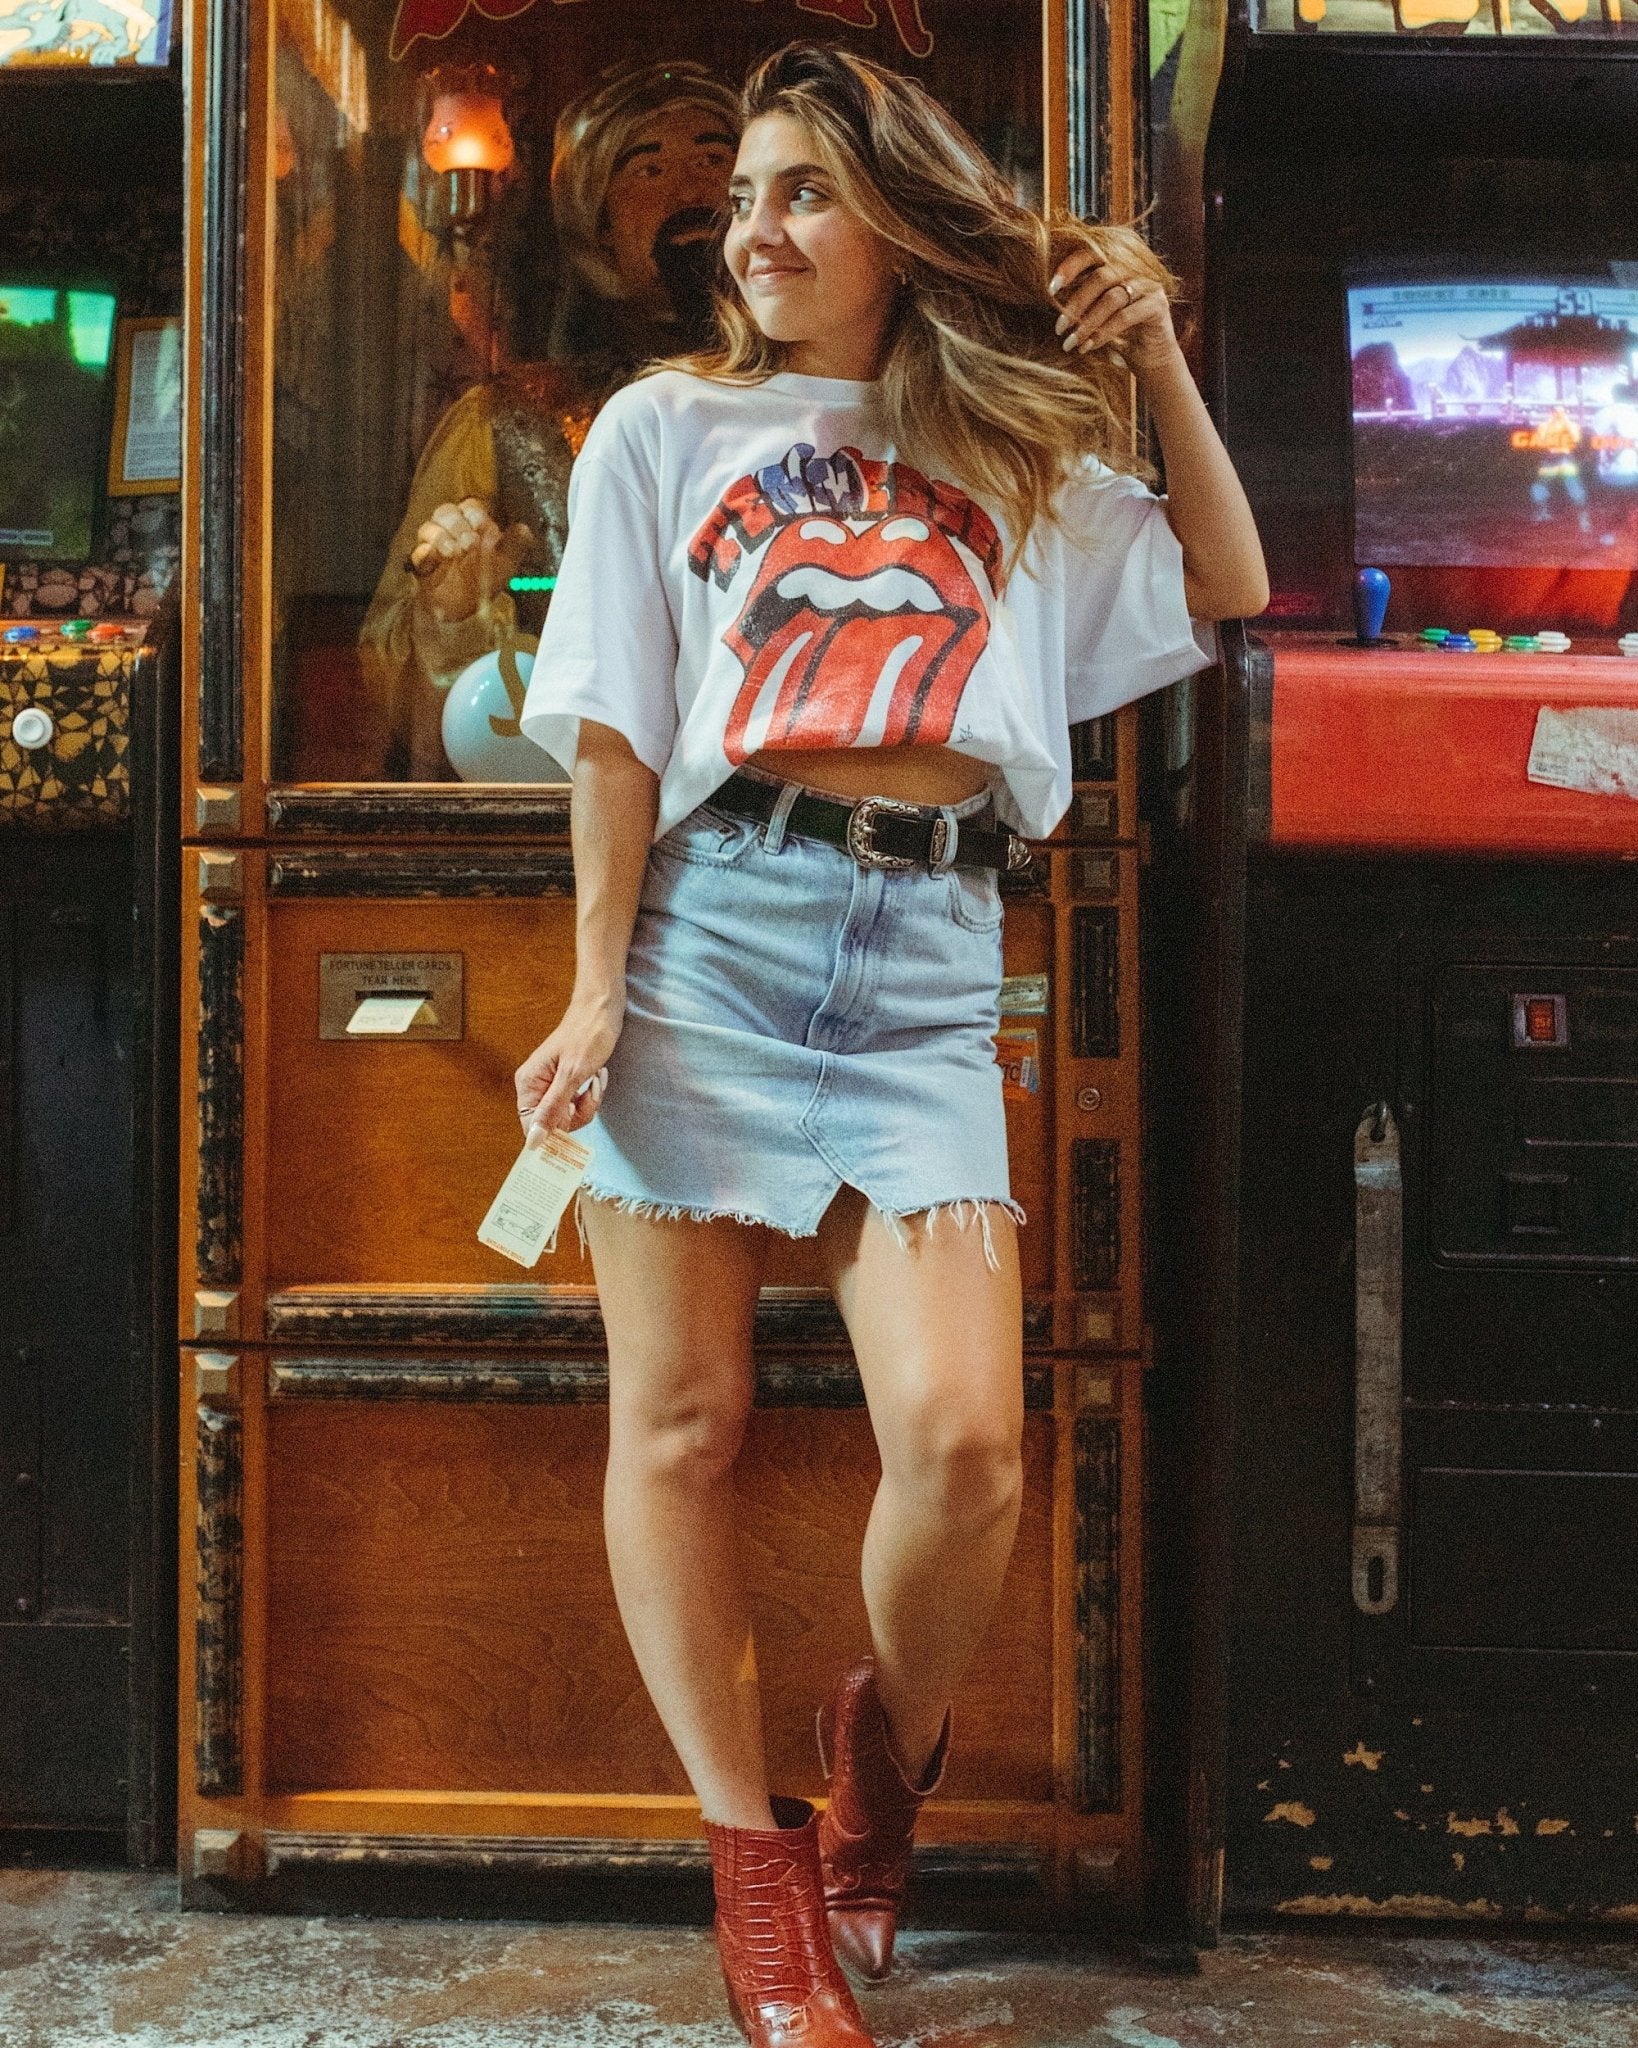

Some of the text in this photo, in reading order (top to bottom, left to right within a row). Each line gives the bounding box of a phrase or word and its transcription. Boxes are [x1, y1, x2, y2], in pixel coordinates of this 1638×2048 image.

[329, 960, 452, 971] FORTUNE TELLER CARDS
[361, 975, 419, 985] TEAR HERE
